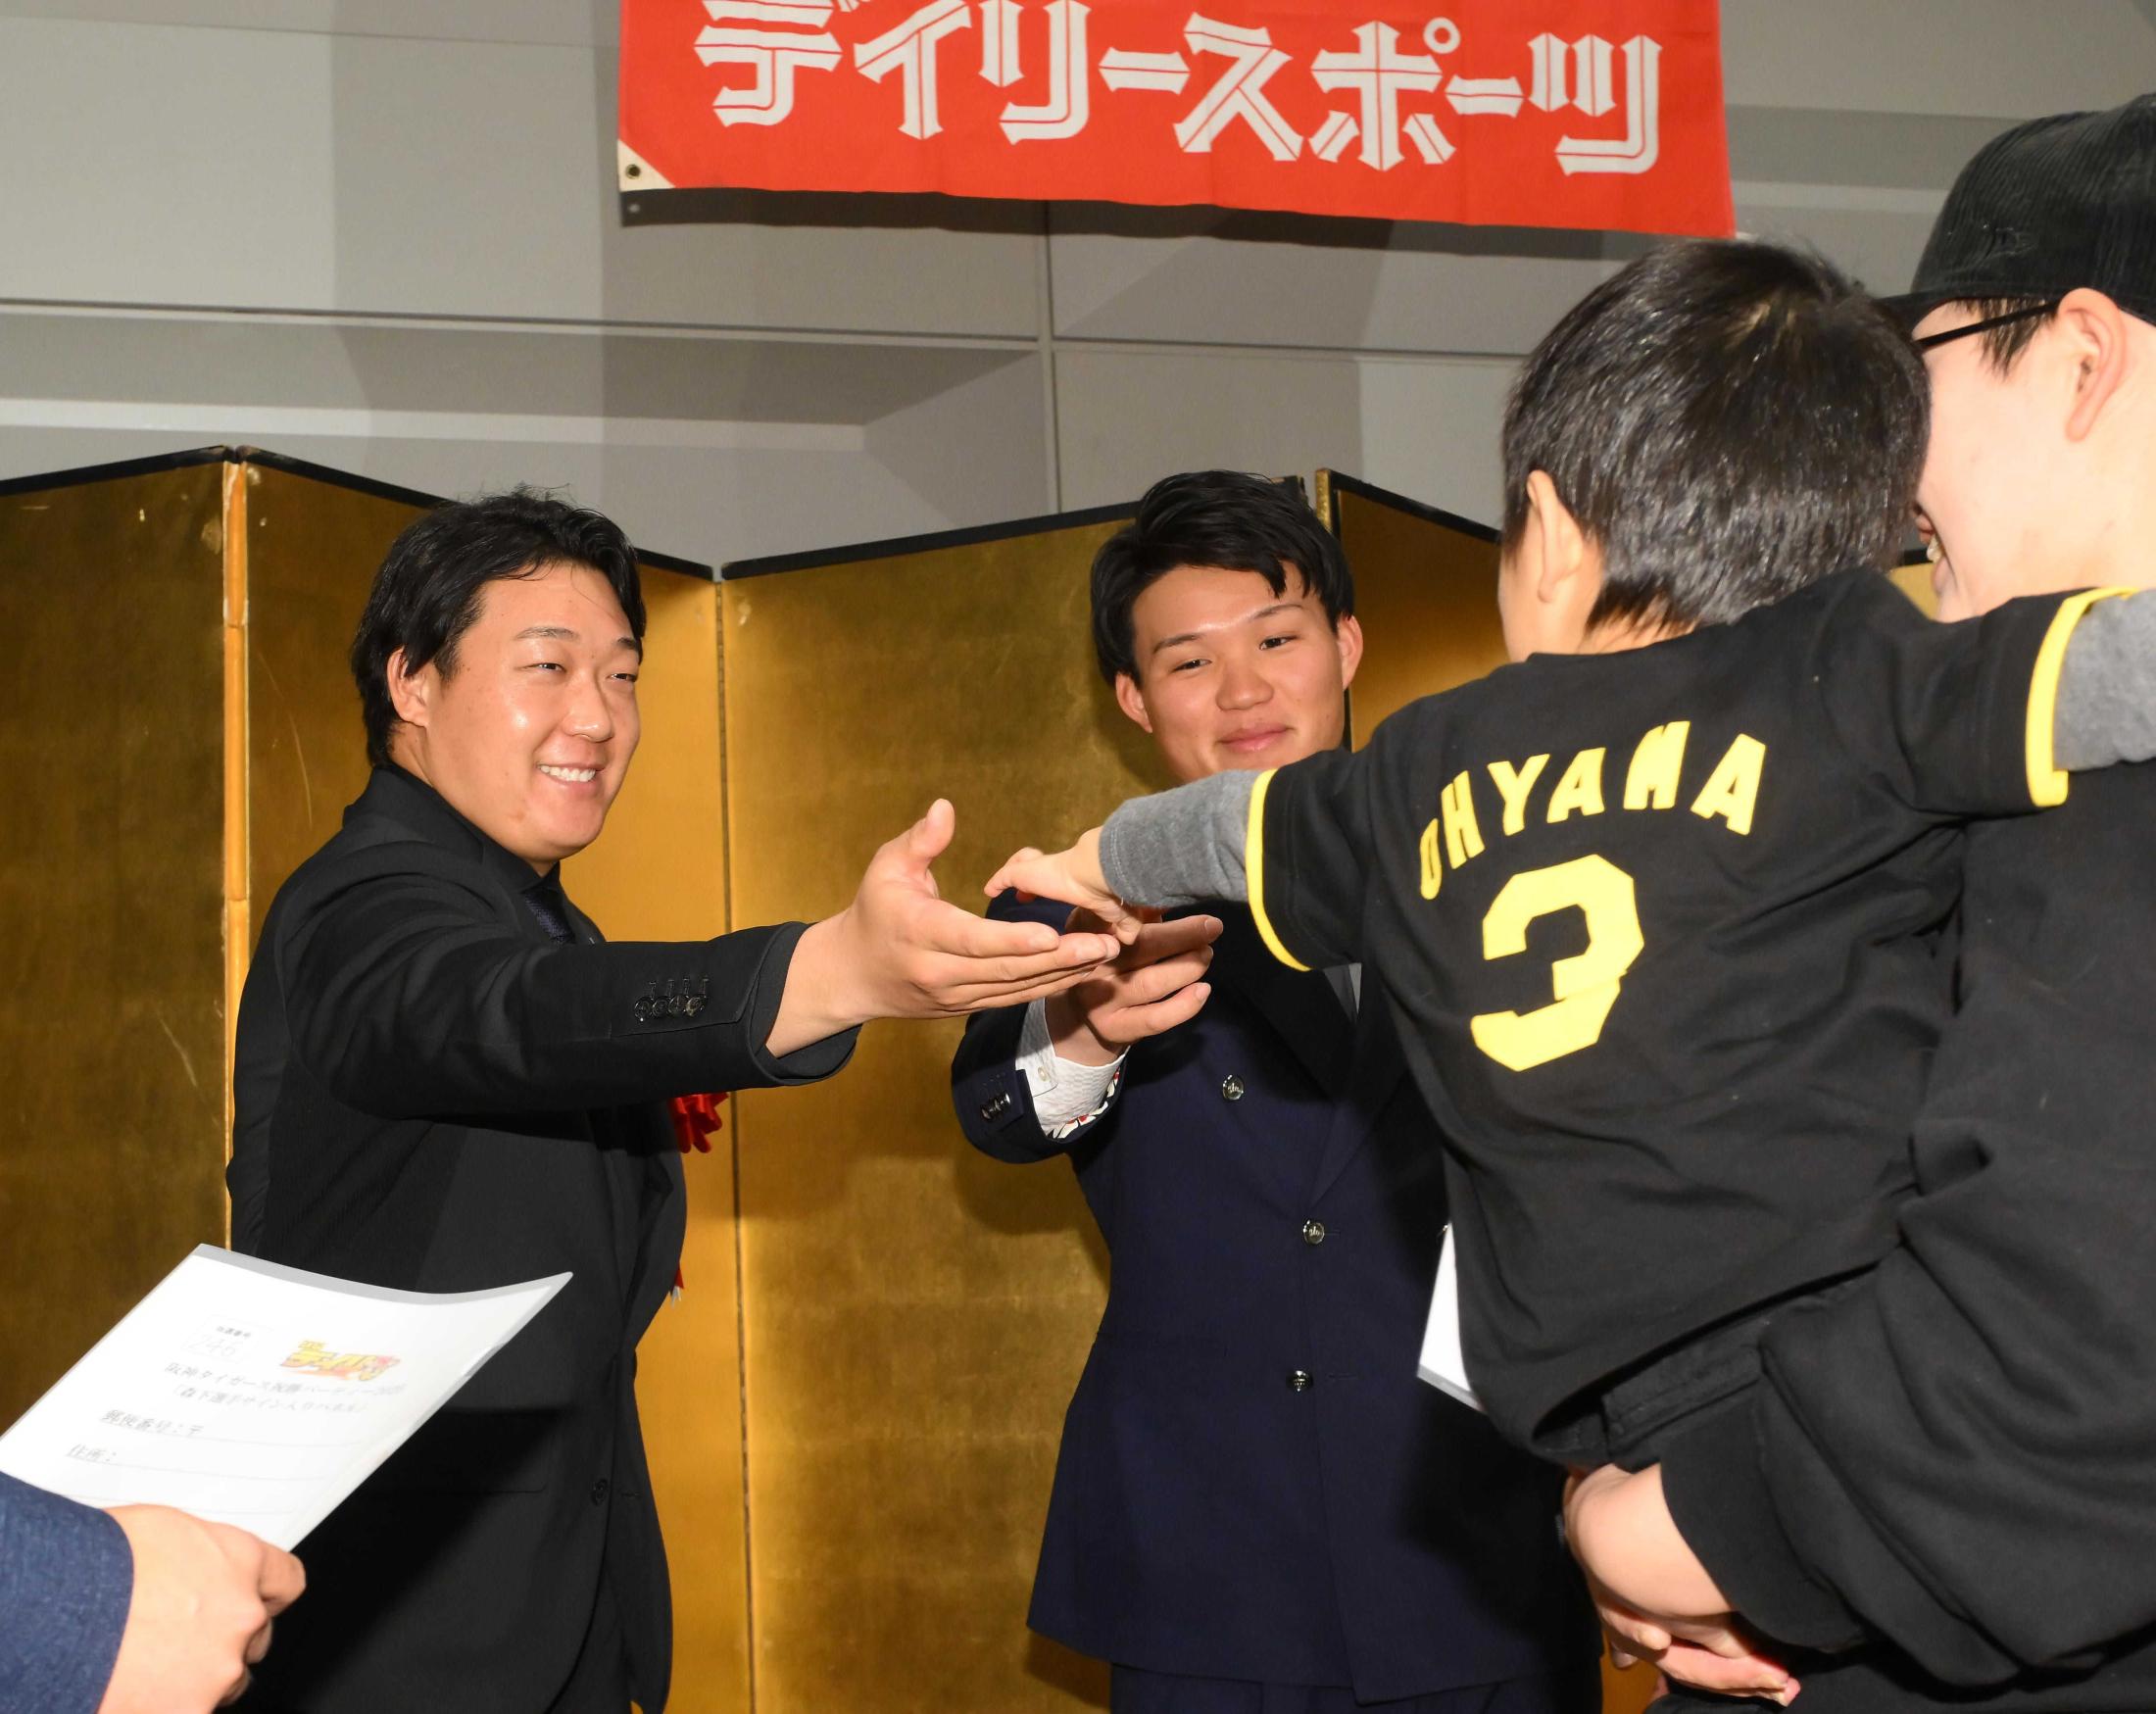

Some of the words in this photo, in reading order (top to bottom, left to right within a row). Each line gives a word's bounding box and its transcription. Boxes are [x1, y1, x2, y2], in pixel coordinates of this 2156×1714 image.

[694, 0, 1663, 175] デイリースポーツ
[1420, 721, 1767, 901] OHYAMA
[1471, 854, 1645, 1072] 3
